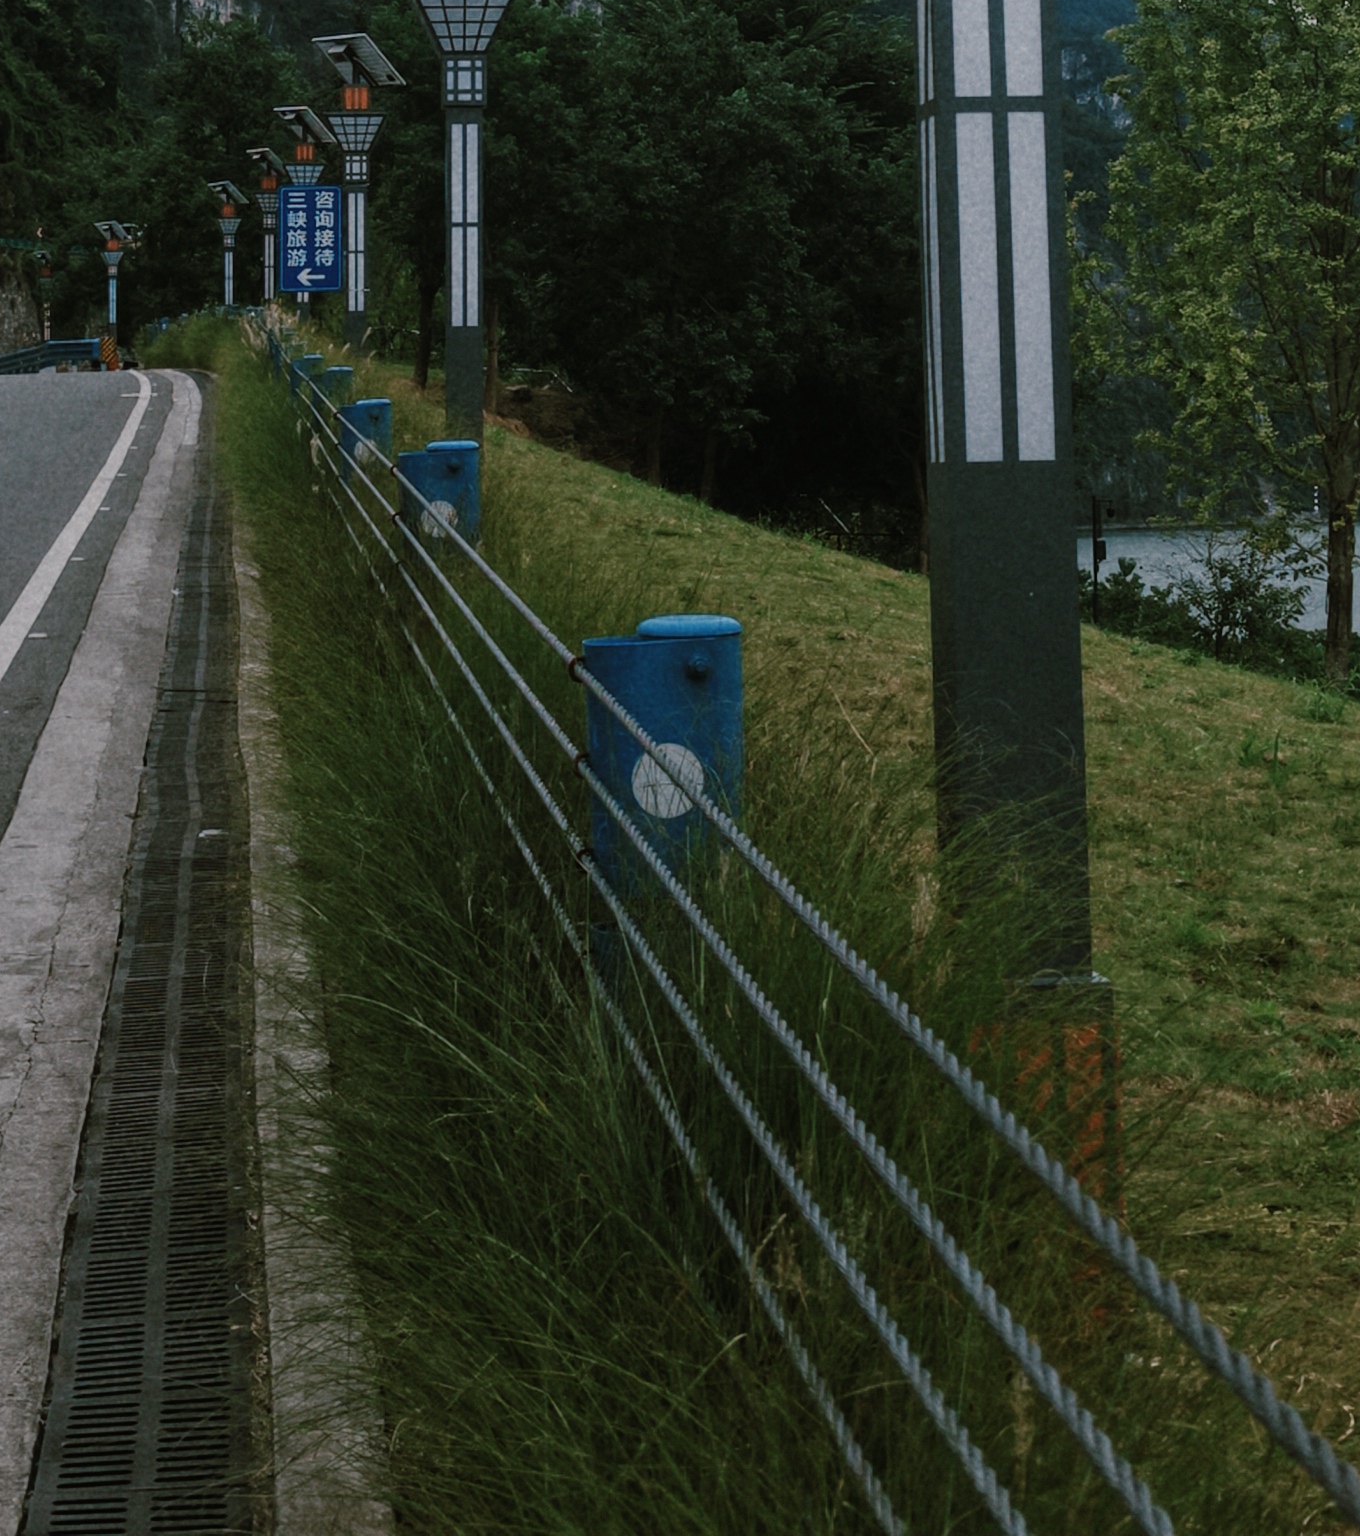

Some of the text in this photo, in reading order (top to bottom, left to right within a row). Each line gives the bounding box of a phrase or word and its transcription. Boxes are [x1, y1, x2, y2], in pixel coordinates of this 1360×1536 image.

[287, 191, 307, 267] 三峡旅游
[314, 191, 335, 267] 咨询接待
